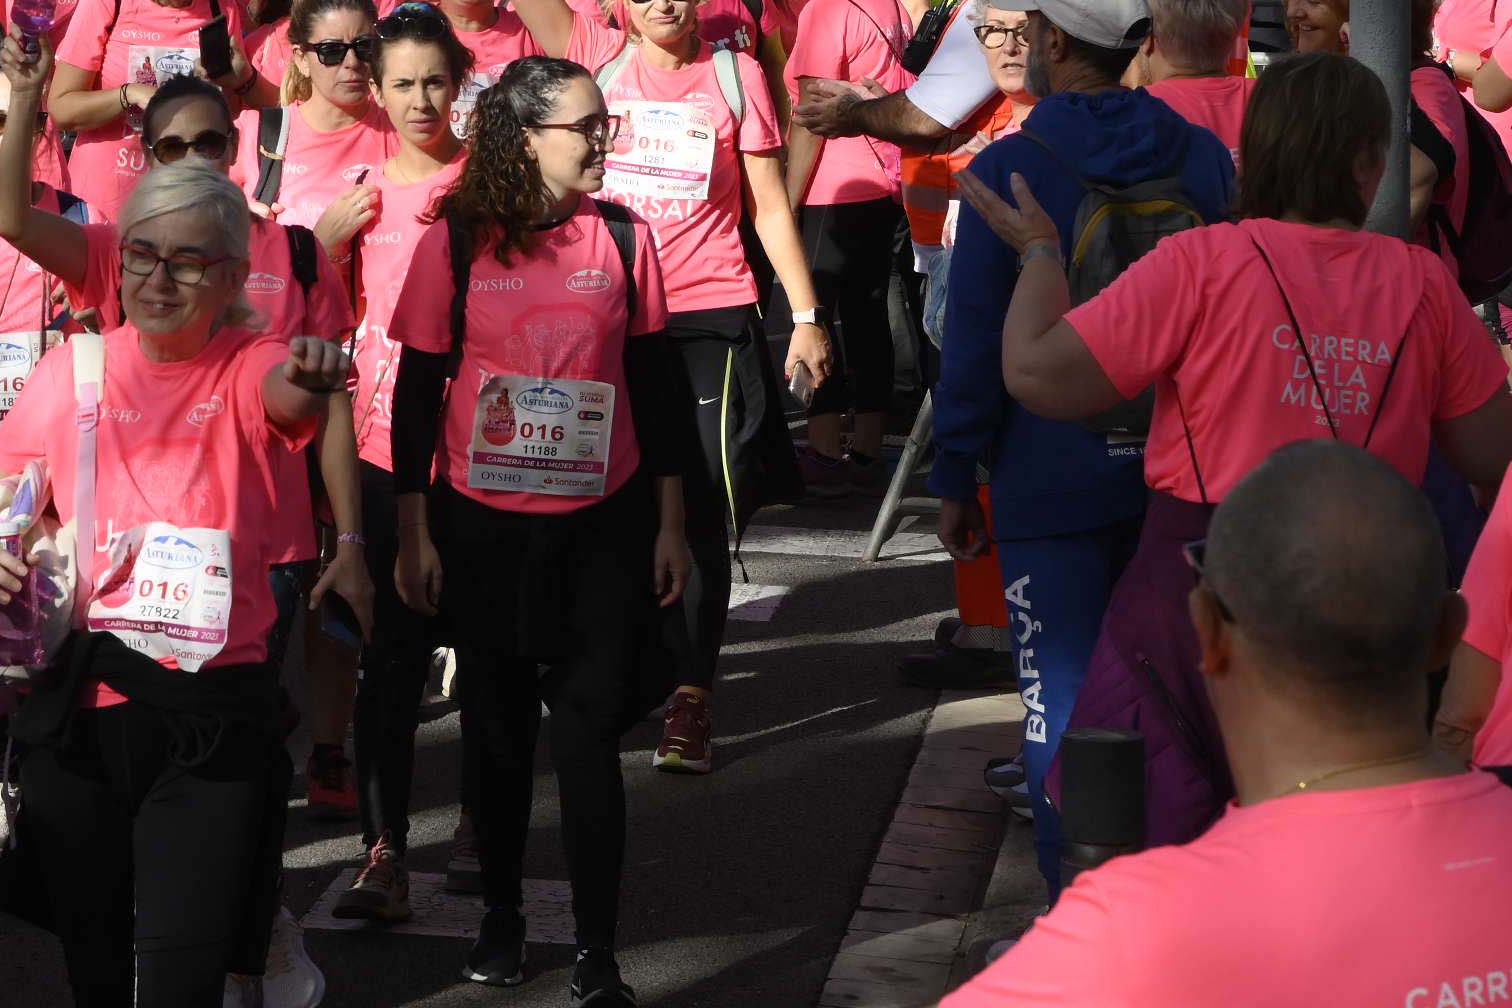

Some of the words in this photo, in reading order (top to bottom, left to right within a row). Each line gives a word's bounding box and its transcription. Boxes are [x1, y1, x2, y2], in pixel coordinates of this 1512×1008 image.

[121, 29, 161, 42] OYSHO
[638, 136, 675, 152] 016
[470, 276, 525, 292] OYSHO
[1334, 365, 1368, 389] LA
[521, 395, 570, 409] ASTURIANA
[519, 422, 566, 442] 016
[522, 444, 558, 457] 11188
[1108, 448, 1137, 457] SINCE
[486, 455, 522, 467] CARRERA
[524, 459, 536, 467] DE
[536, 460, 546, 468] LA
[547, 461, 574, 470] MUJER
[481, 471, 522, 484] OYSHO
[553, 477, 595, 488] Santander
[139, 579, 190, 602] 016
[104, 619, 143, 631] CARRERA
[144, 623, 157, 632] DE
[168, 626, 199, 640] MUJER
[1005, 575, 1047, 744] BARÇA
[1405, 971, 1512, 1008] CARR
